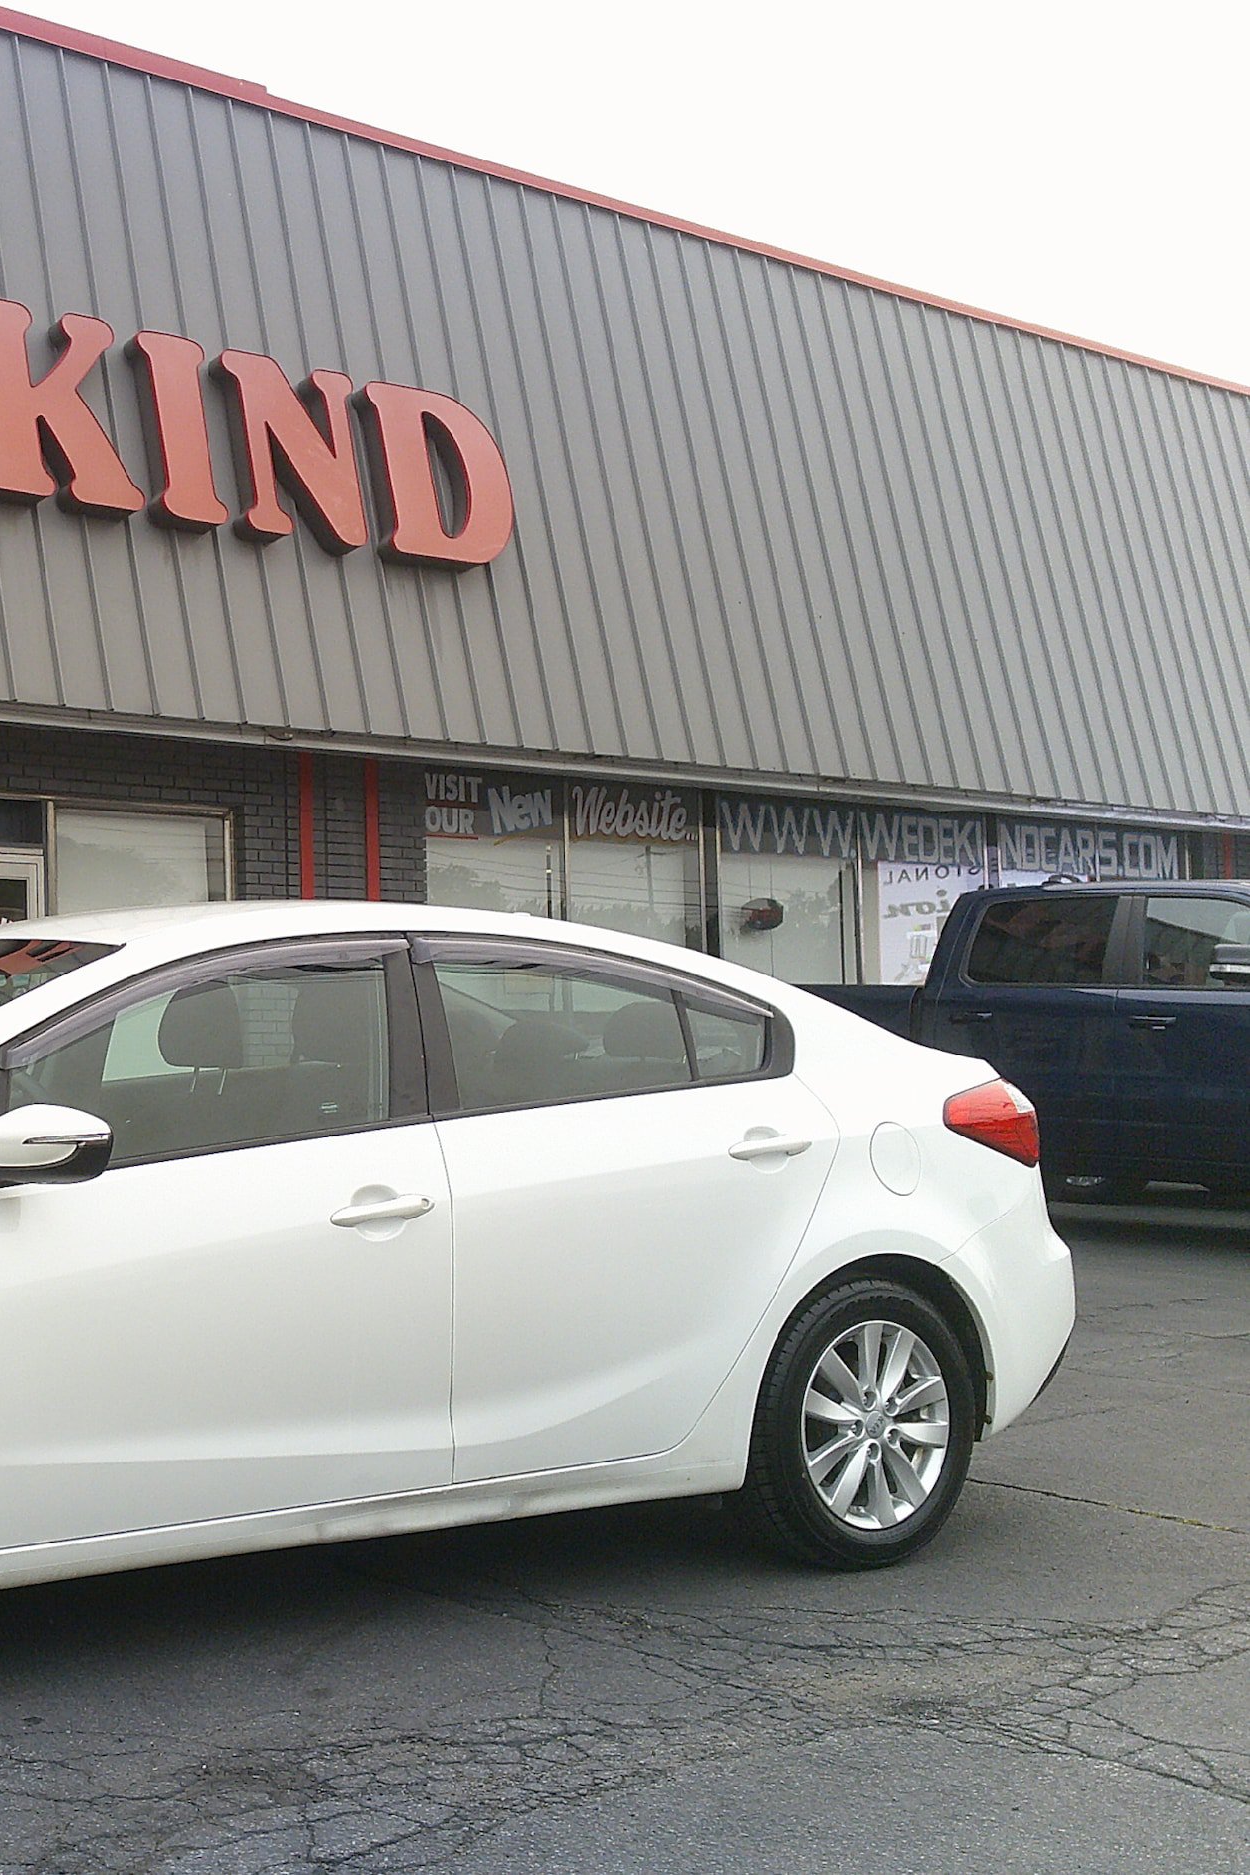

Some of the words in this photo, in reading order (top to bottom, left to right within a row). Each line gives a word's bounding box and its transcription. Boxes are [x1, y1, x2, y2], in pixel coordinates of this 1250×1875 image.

[424, 772, 483, 803] VISIT
[425, 805, 475, 834] OUR
[487, 784, 553, 834] New
